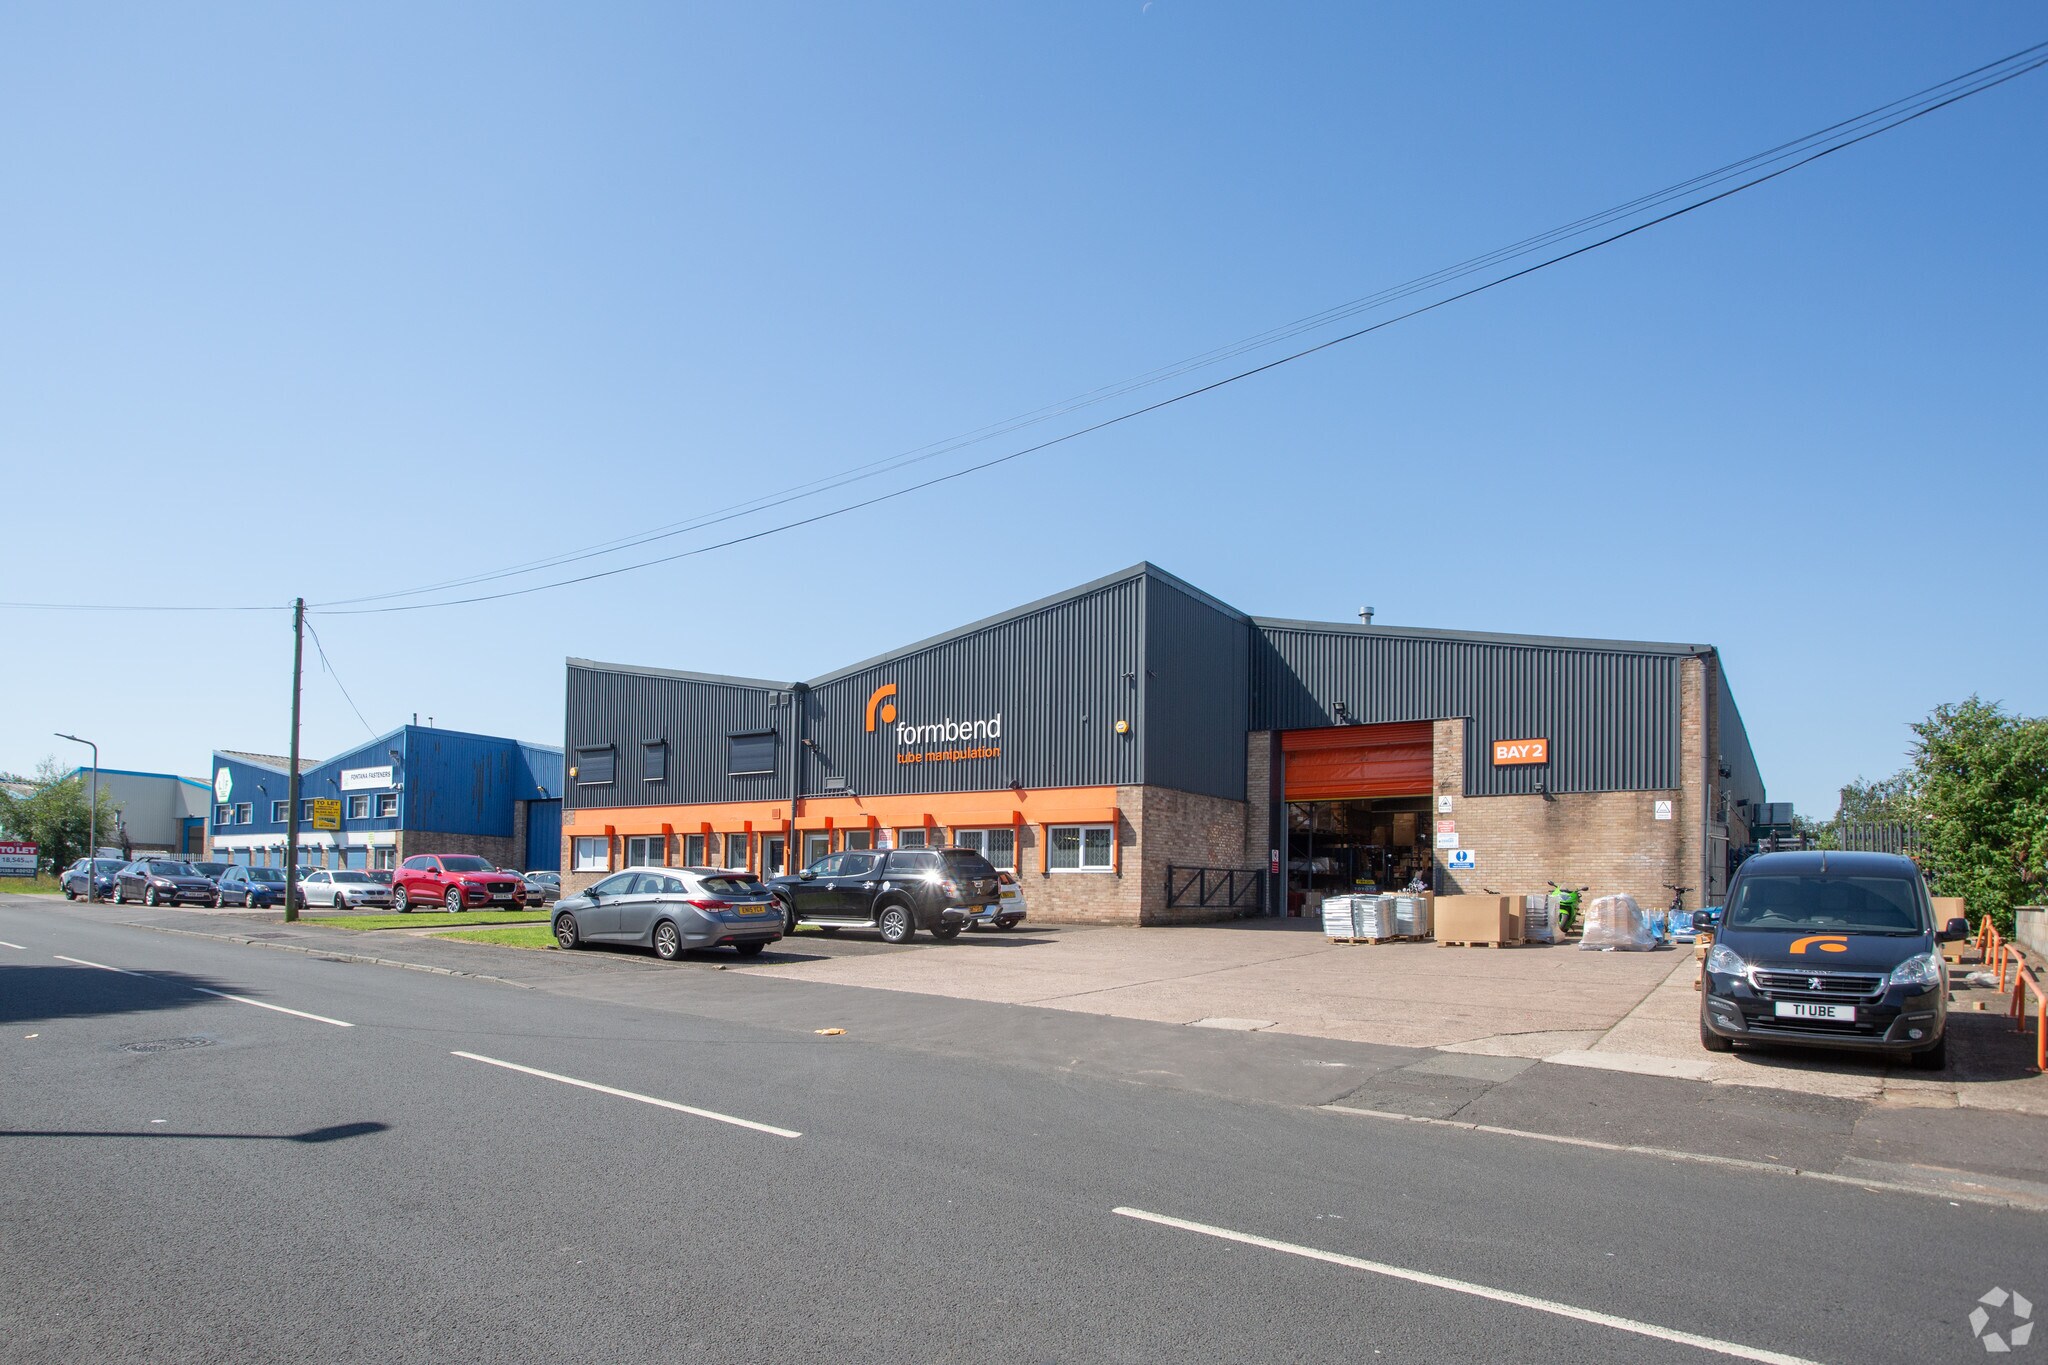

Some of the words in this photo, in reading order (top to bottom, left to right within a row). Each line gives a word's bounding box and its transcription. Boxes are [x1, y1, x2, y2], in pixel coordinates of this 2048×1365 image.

[896, 713, 1001, 745] formbend
[896, 751, 923, 764] tube
[925, 745, 1001, 763] manipulation
[1496, 745, 1530, 759] BAY
[1532, 744, 1543, 757] 2
[1809, 1005, 1836, 1017] UBE
